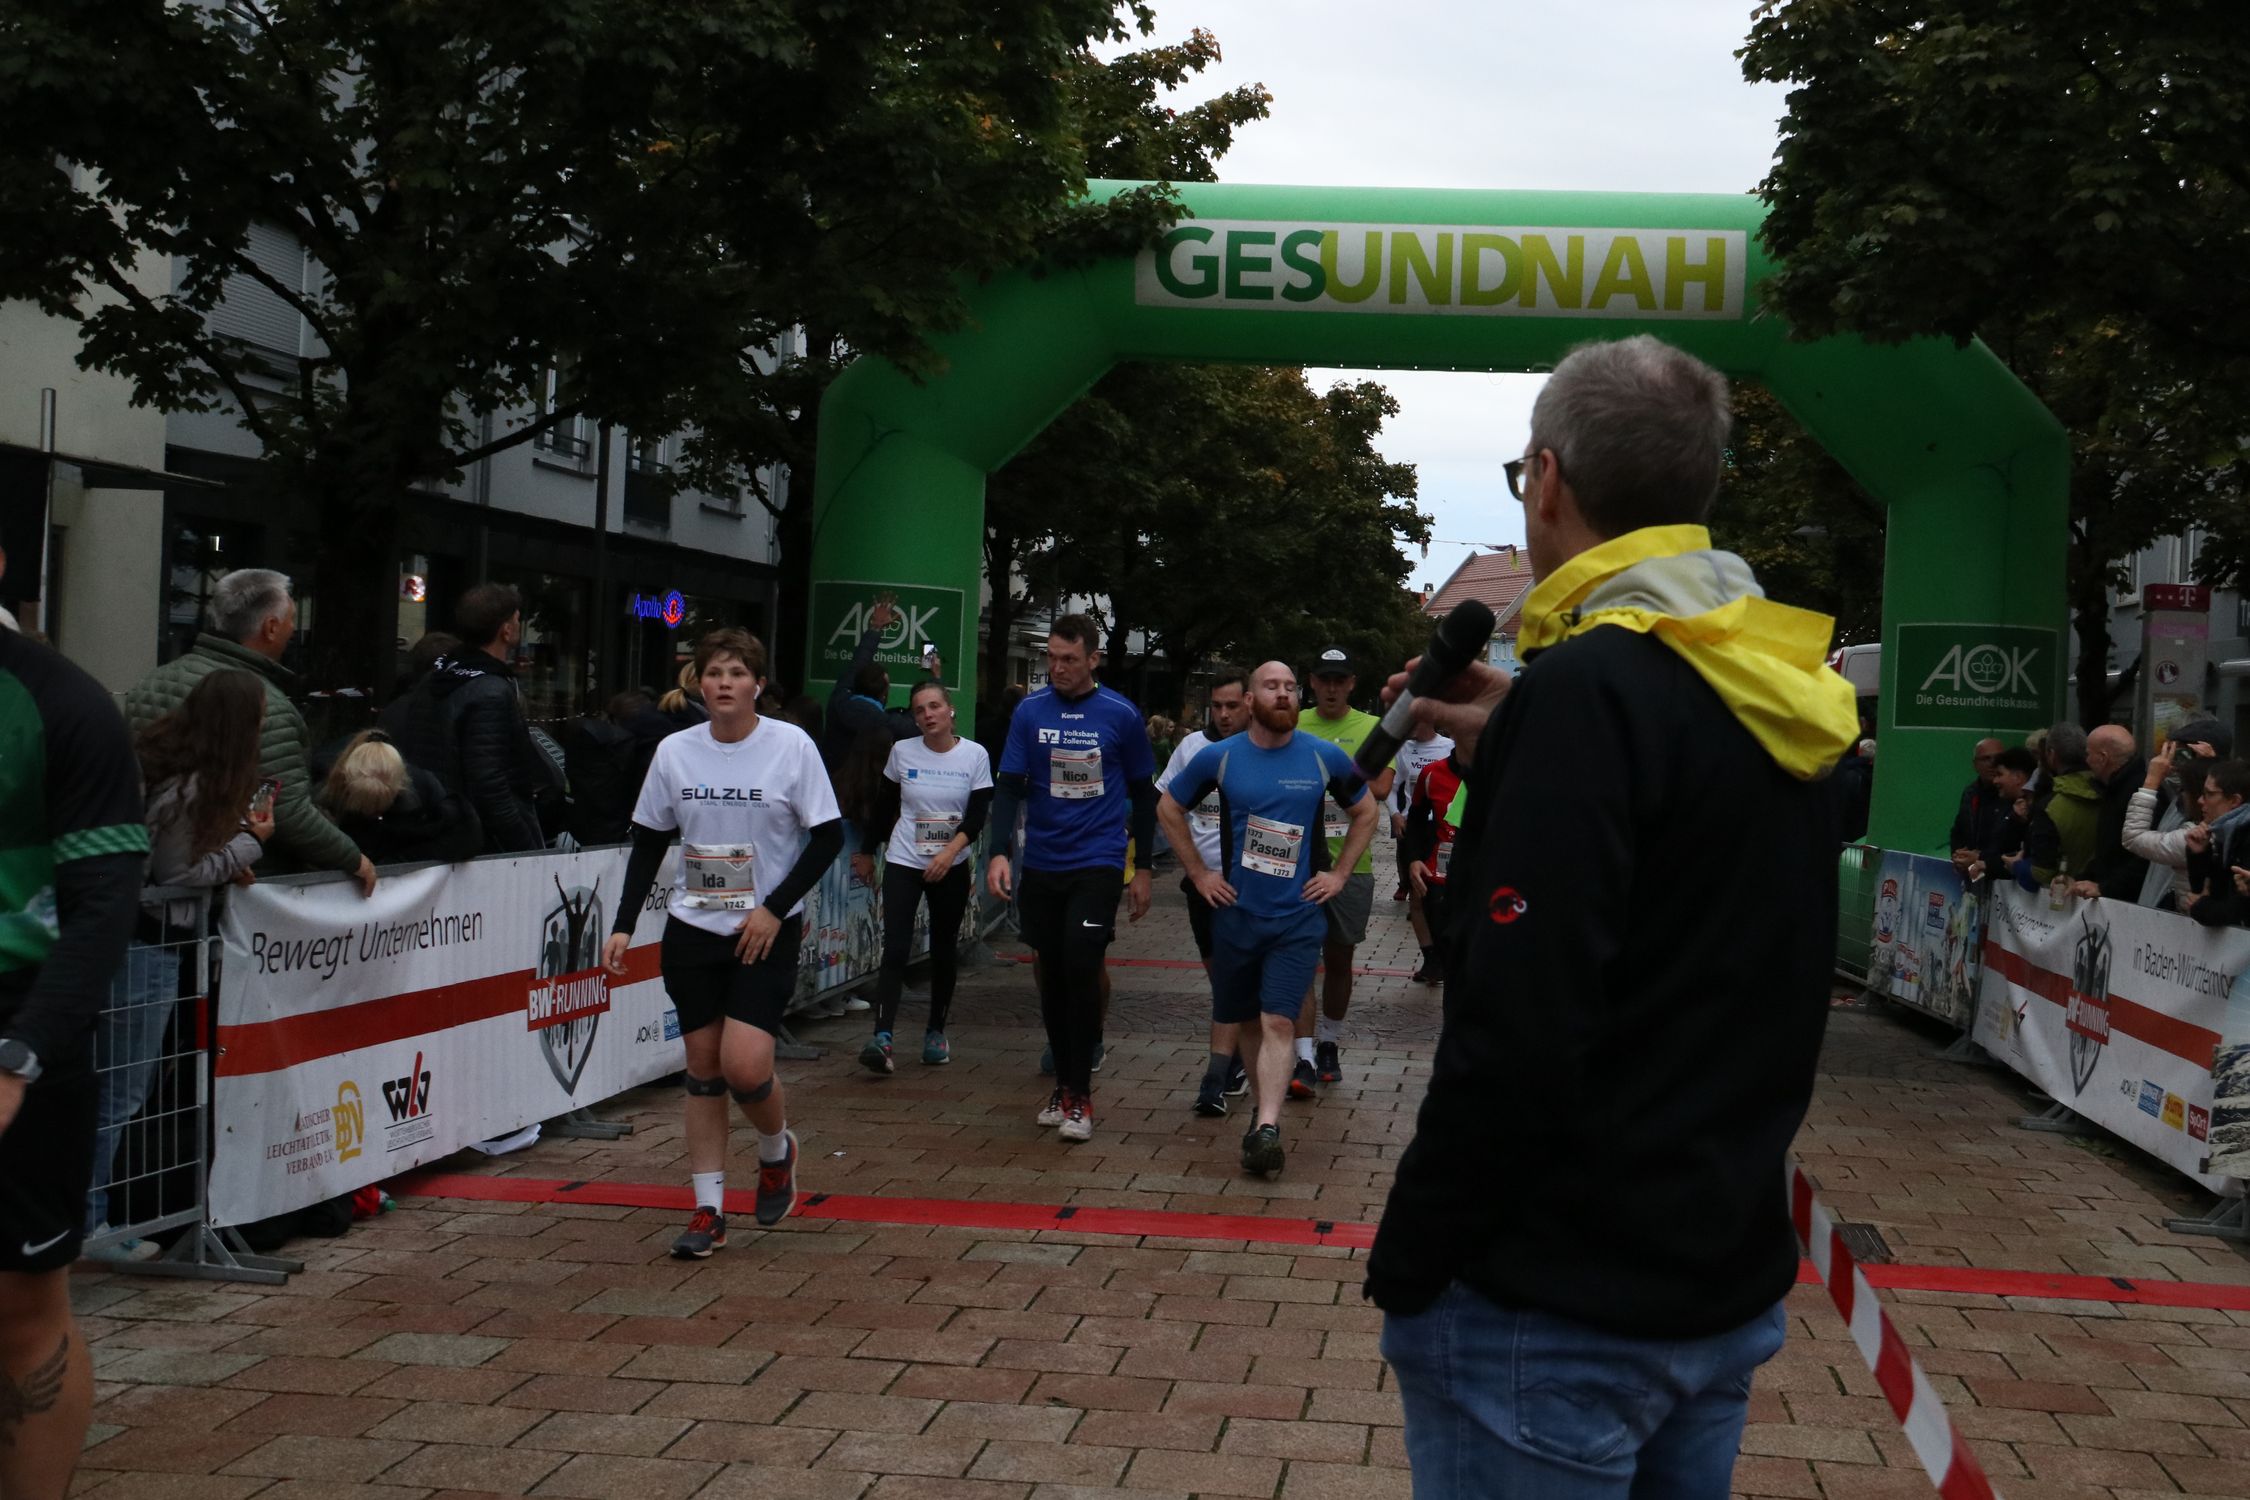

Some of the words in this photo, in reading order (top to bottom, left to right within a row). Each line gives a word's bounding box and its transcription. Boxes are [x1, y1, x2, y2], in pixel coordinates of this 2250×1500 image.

[1154, 226, 1726, 311] GESUNDNAH
[633, 593, 662, 617] Apollo
[828, 602, 940, 651] AOK
[824, 650, 839, 660] Die
[1920, 643, 2039, 695] AOK
[1916, 693, 1933, 705] Die
[1063, 730, 1099, 739] Volksbank
[1062, 738, 1098, 746] Zollernalb
[1062, 771, 1088, 782] Nico
[681, 784, 763, 801] SÜLZLE
[925, 830, 950, 840] Julia
[1247, 829, 1263, 839] 1373
[1250, 839, 1291, 859] Pascal
[686, 861, 702, 870] 1742
[1273, 867, 1290, 877] 1373
[702, 873, 726, 888] Ida
[724, 901, 746, 909] 1742
[252, 928, 353, 981] Bewegt
[360, 907, 483, 962] Unternehmen
[528, 973, 608, 1022] BW-RUNNING
